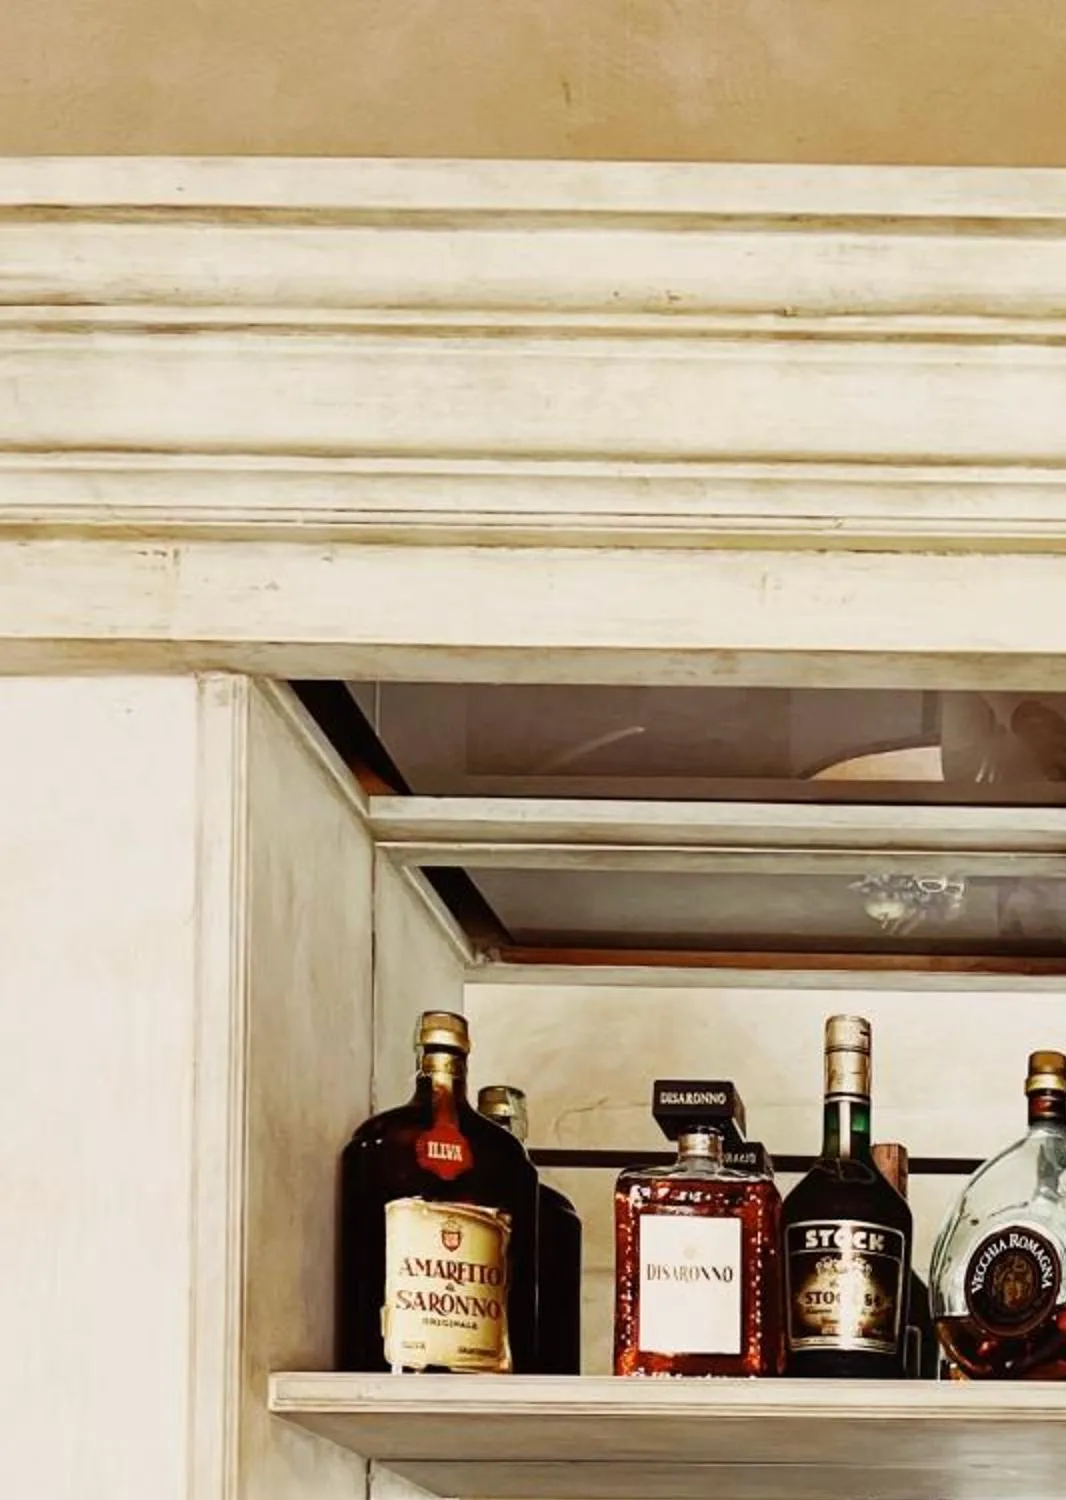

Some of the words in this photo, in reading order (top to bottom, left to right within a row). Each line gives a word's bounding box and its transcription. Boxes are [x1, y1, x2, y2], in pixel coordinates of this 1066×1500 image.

[659, 1091, 728, 1105] DISARONNO
[805, 1229, 885, 1251] STOCK
[400, 1257, 500, 1287] AMARETTO
[647, 1263, 733, 1282] DISARONNO
[971, 1240, 1007, 1294] VECCHIA
[1009, 1233, 1053, 1289] ROMAGNA
[396, 1291, 501, 1321] SARONNO
